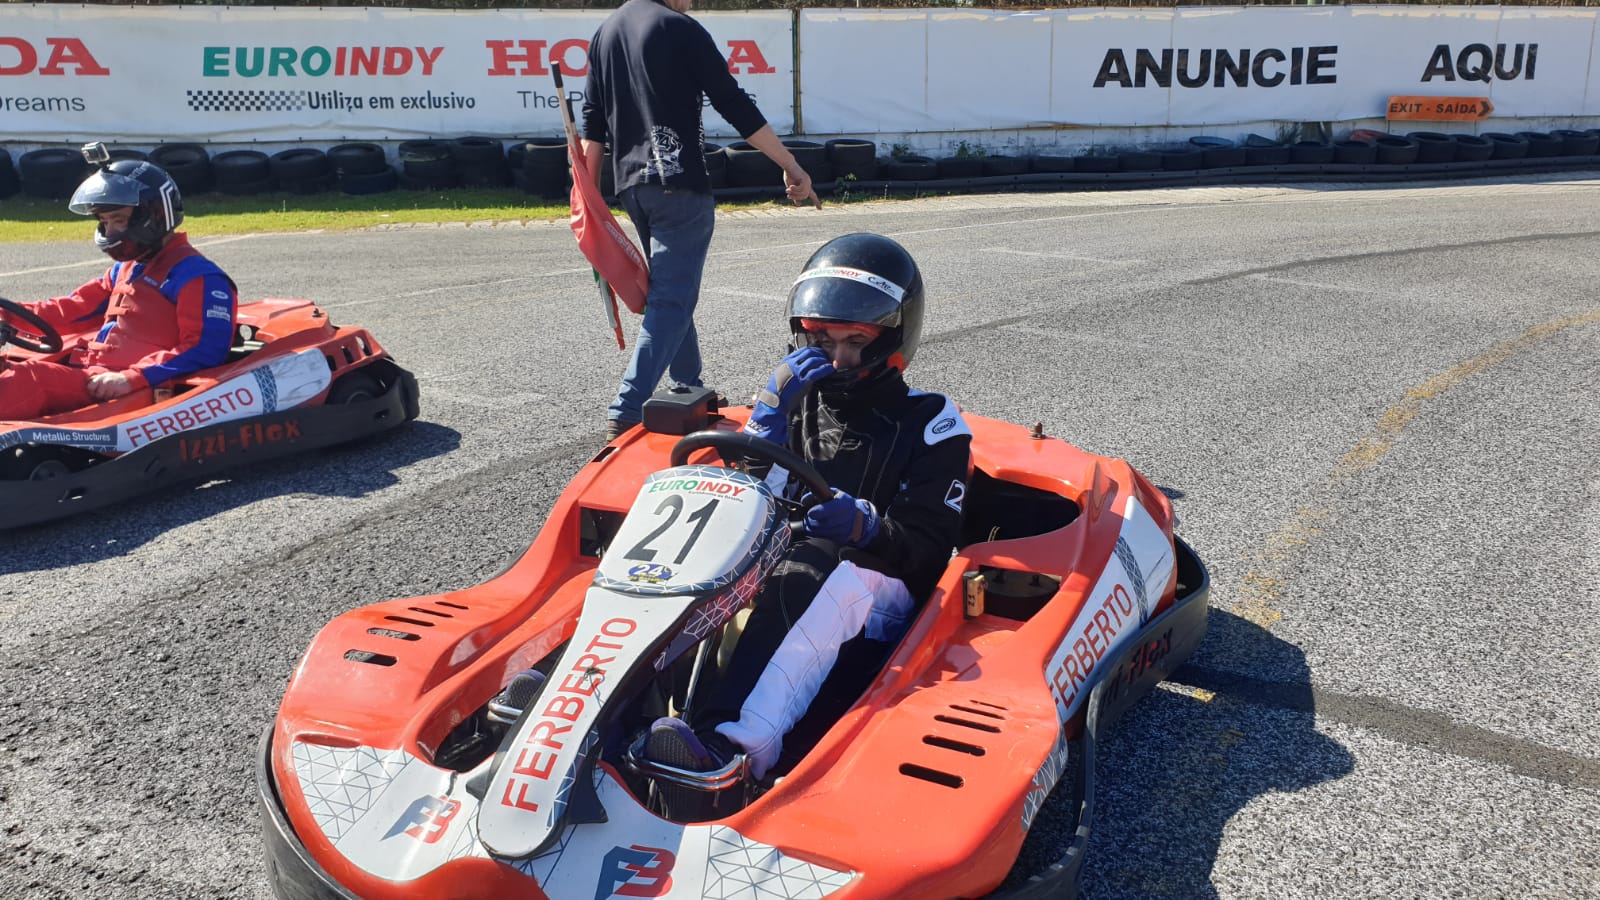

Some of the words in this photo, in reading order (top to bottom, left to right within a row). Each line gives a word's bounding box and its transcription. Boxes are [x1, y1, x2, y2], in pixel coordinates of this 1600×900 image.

[202, 46, 445, 77] EUROINDY
[1093, 45, 1338, 88] ANUNCIE
[1420, 43, 1538, 83] AQUI
[0, 95, 86, 112] reams
[369, 95, 395, 109] em
[400, 91, 476, 110] exclusivo
[516, 91, 560, 109] The
[1390, 103, 1422, 113] EXIT
[126, 387, 254, 448] FERBERTO
[32, 431, 71, 441] Metallic
[72, 431, 111, 442] Structures
[648, 480, 746, 497] EUROINDY
[623, 494, 720, 565] 21
[500, 617, 638, 812] FERBERTO
